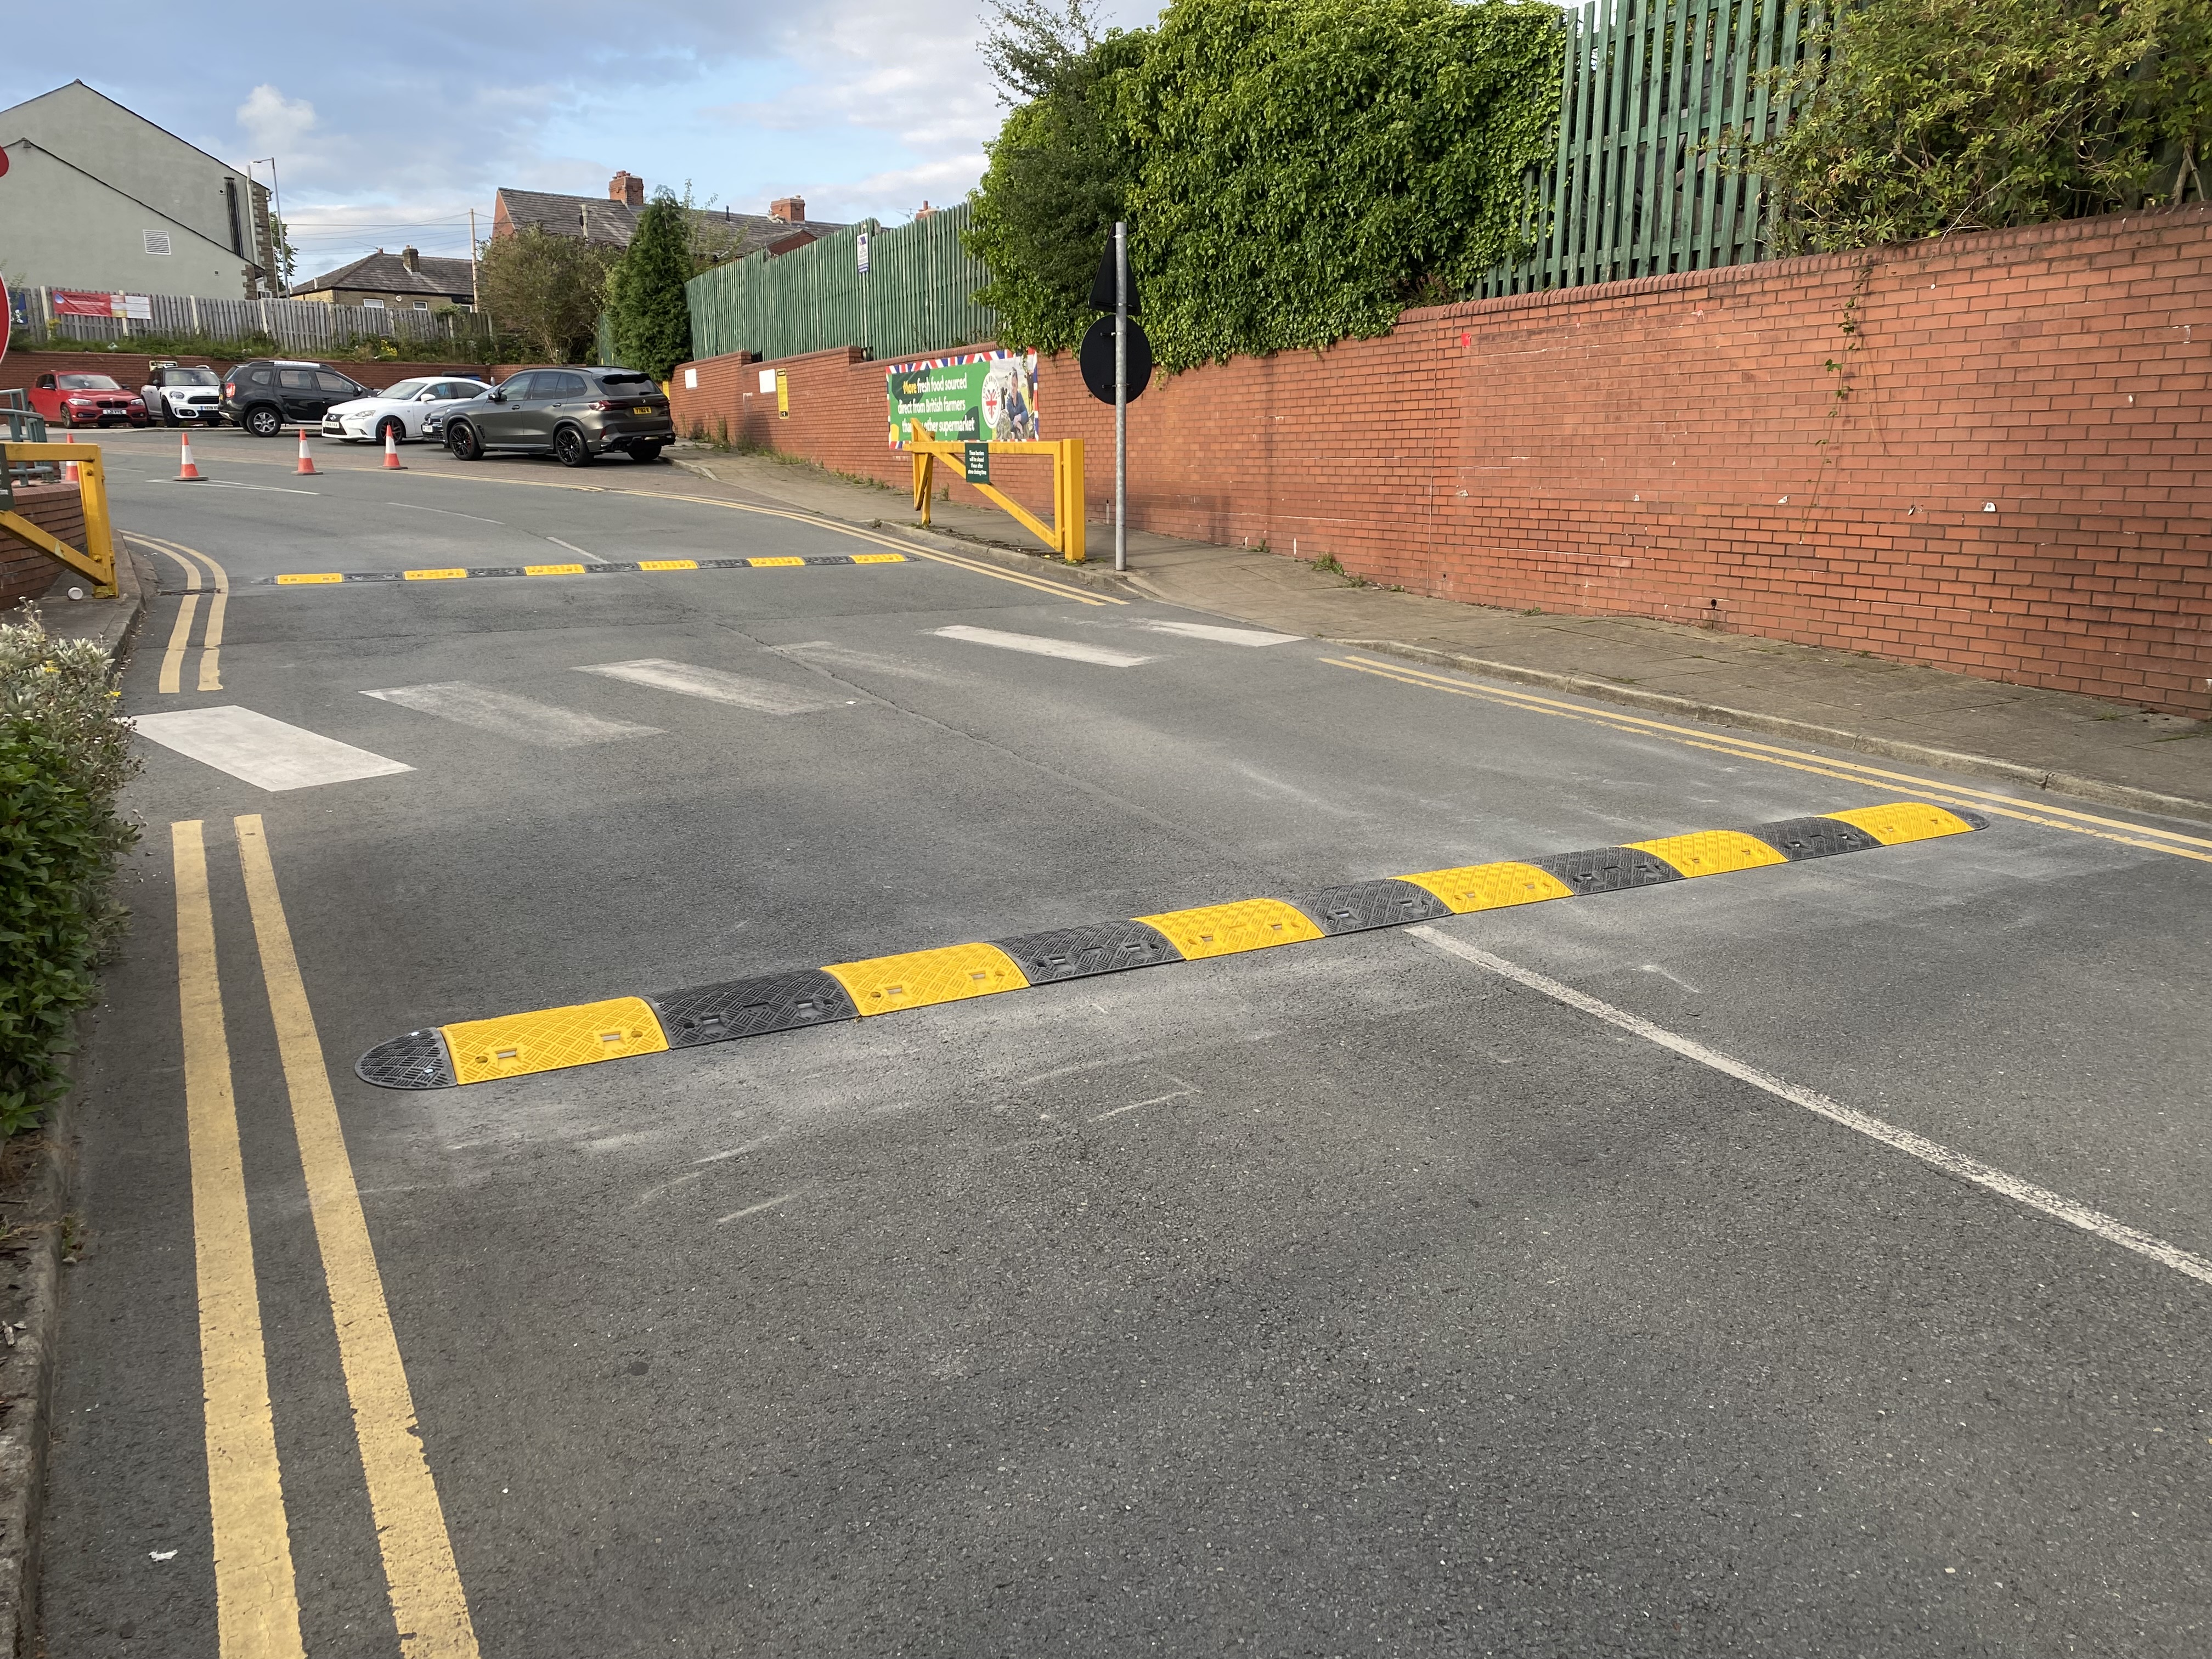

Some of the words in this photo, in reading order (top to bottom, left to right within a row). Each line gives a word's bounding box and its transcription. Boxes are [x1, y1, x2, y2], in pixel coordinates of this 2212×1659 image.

[902, 380, 917, 394] More
[917, 376, 930, 393] fresh
[931, 375, 944, 392] food
[945, 372, 967, 391] sourced
[898, 399, 913, 414] direct
[912, 398, 926, 413] from
[926, 396, 943, 412] British
[943, 396, 966, 411] farmers
[923, 416, 939, 432] other
[939, 415, 975, 437] supermarket
